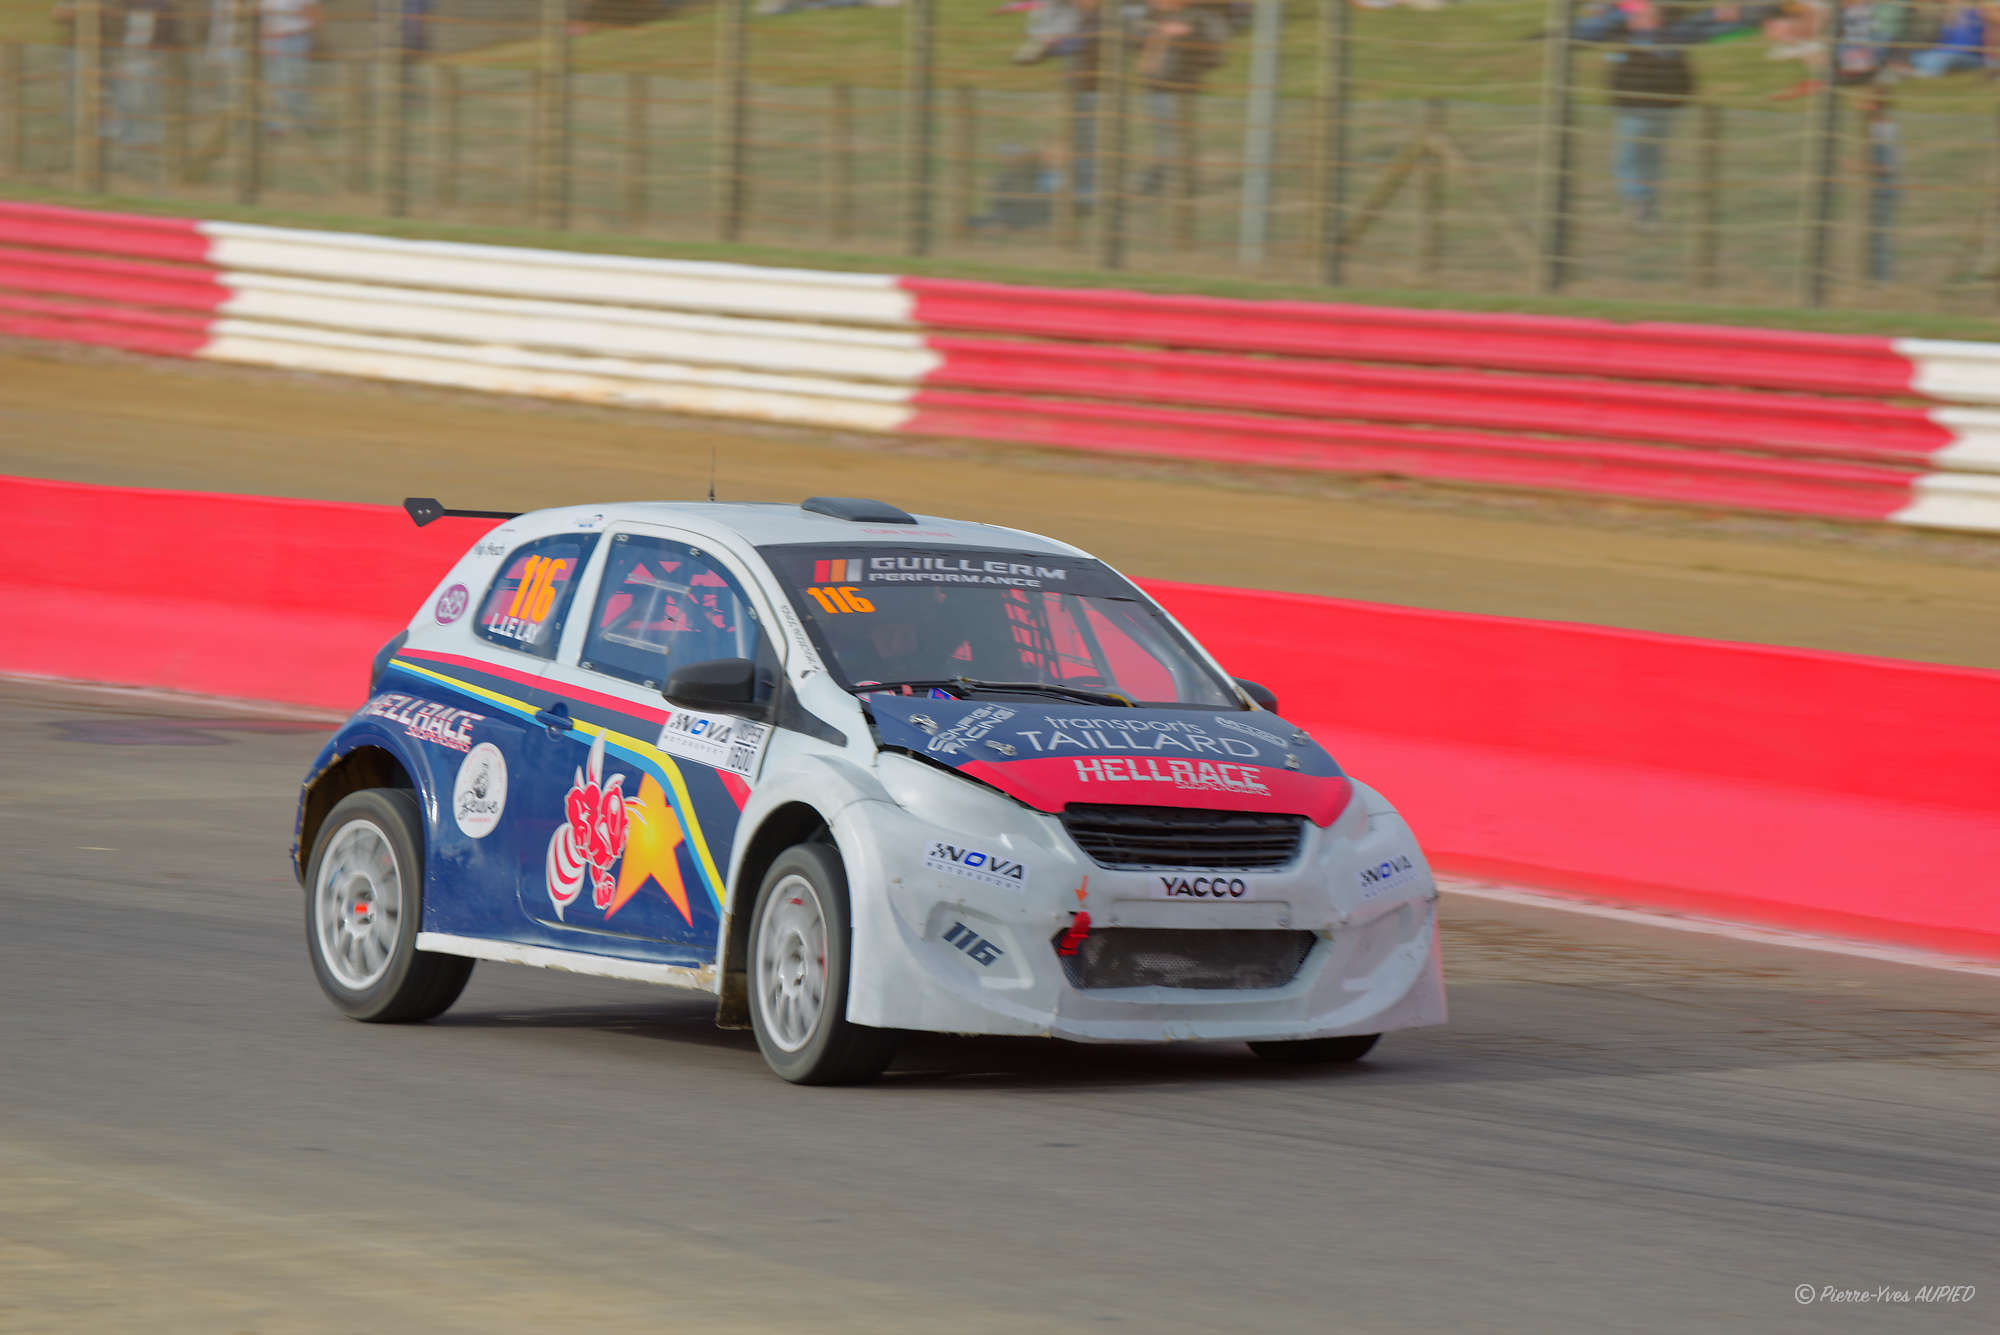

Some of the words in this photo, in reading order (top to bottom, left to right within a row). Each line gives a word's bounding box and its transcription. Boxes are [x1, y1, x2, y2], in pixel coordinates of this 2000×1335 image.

[868, 572, 1042, 588] PERFORMANCE
[869, 556, 1067, 581] GUILLERM
[507, 554, 568, 623] 116
[805, 586, 877, 614] 116
[682, 714, 733, 744] NOVA
[1044, 714, 1208, 735] transports
[1016, 731, 1260, 758] TAILLARD
[1073, 758, 1270, 790] HELLRACE
[945, 845, 1025, 880] NOVA
[1160, 876, 1246, 898] YACCO
[942, 921, 1005, 967] 116
